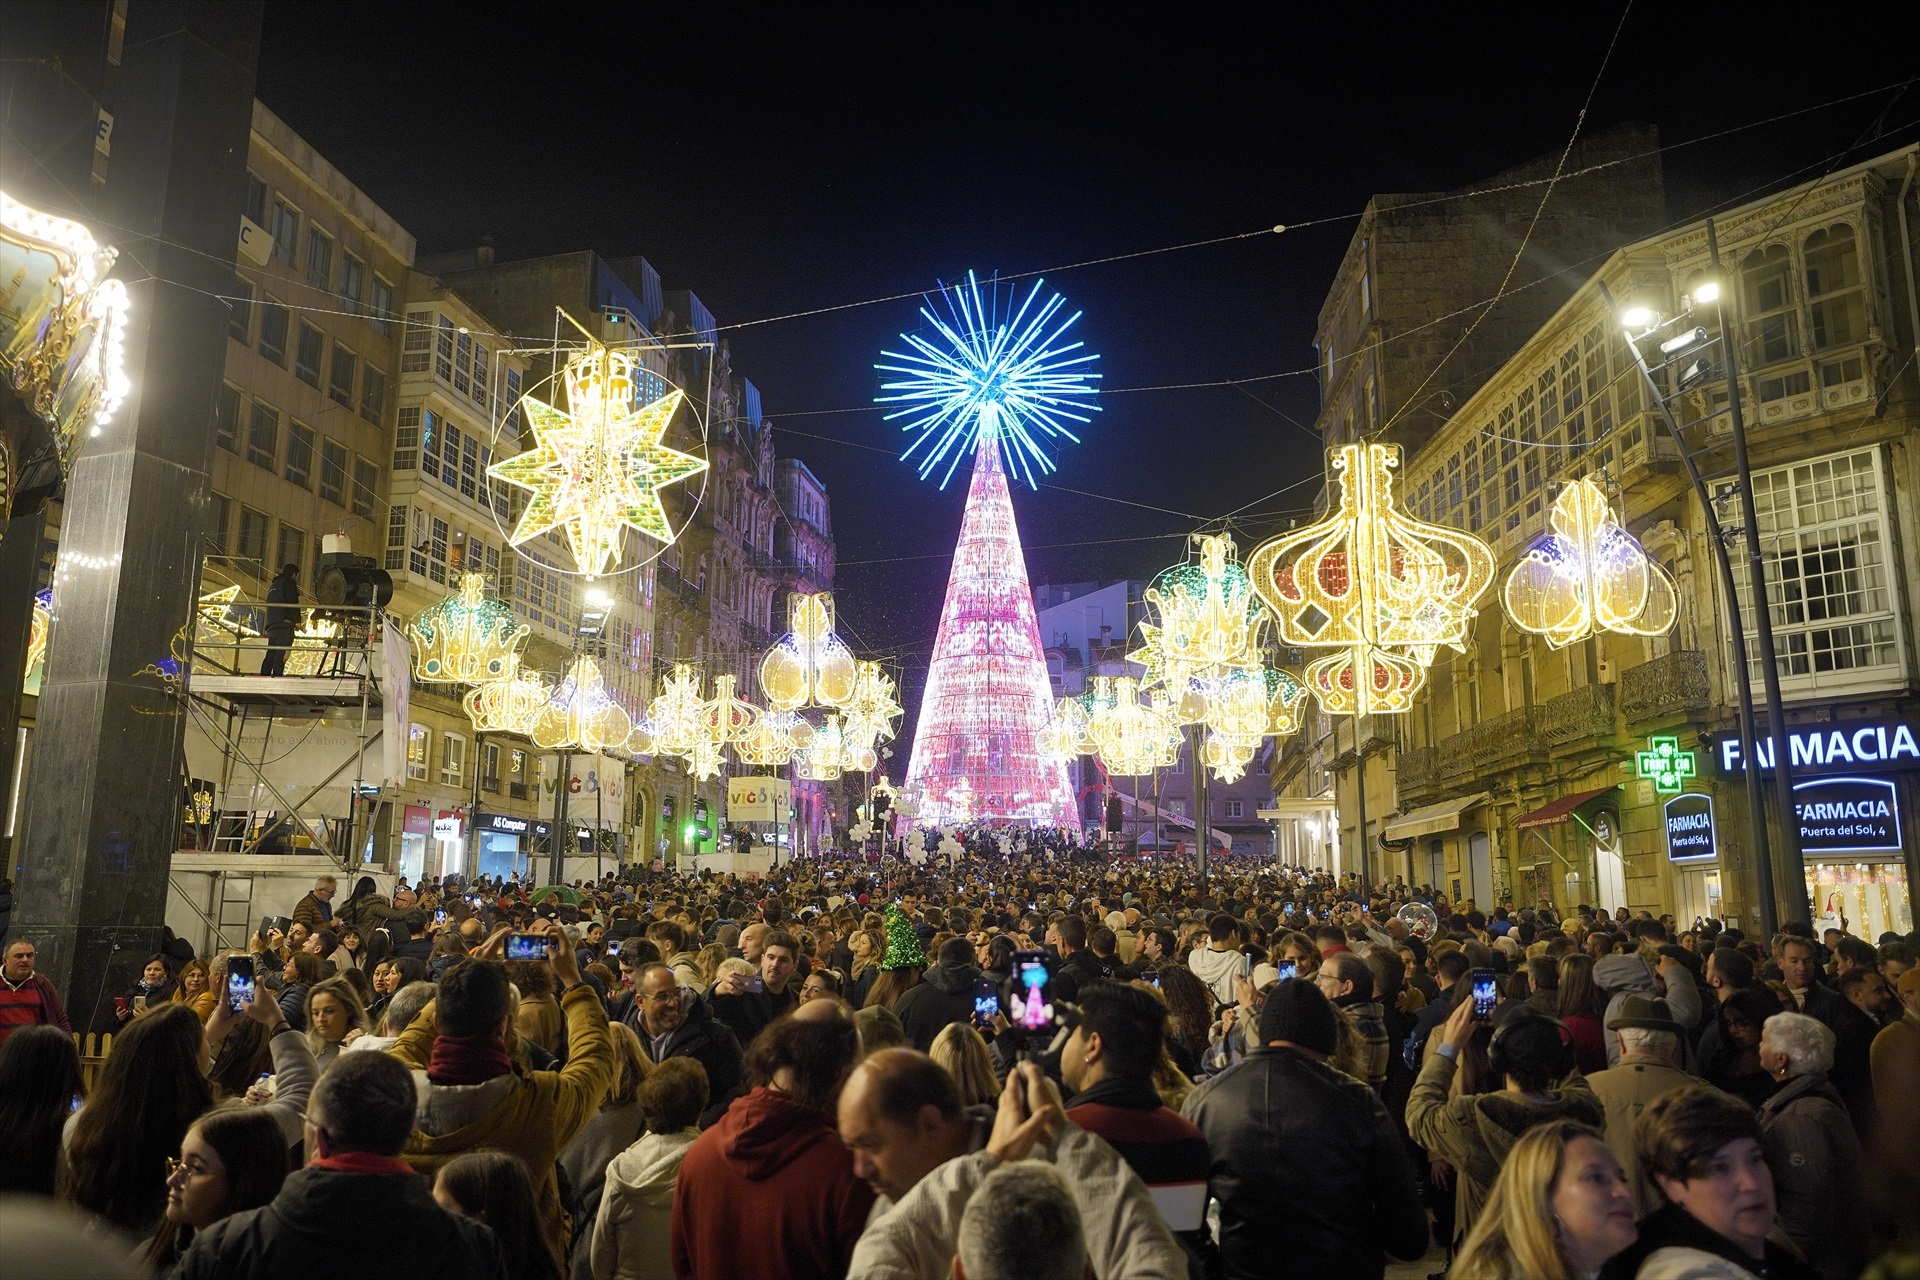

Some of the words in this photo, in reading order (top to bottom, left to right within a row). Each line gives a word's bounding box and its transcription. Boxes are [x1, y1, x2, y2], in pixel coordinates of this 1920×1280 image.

[493, 816, 502, 828] AS
[502, 817, 527, 831] Computer
[1668, 813, 1710, 833] FARMACIA
[1800, 826, 1835, 838] Puerta
[1838, 825, 1853, 836] del
[1855, 824, 1876, 837] Sol,
[1878, 826, 1886, 836] 4
[1672, 837, 1688, 847] Puerta
[1688, 836, 1696, 845] del
[1696, 834, 1705, 845] Sol,
[1705, 836, 1709, 845] 4
